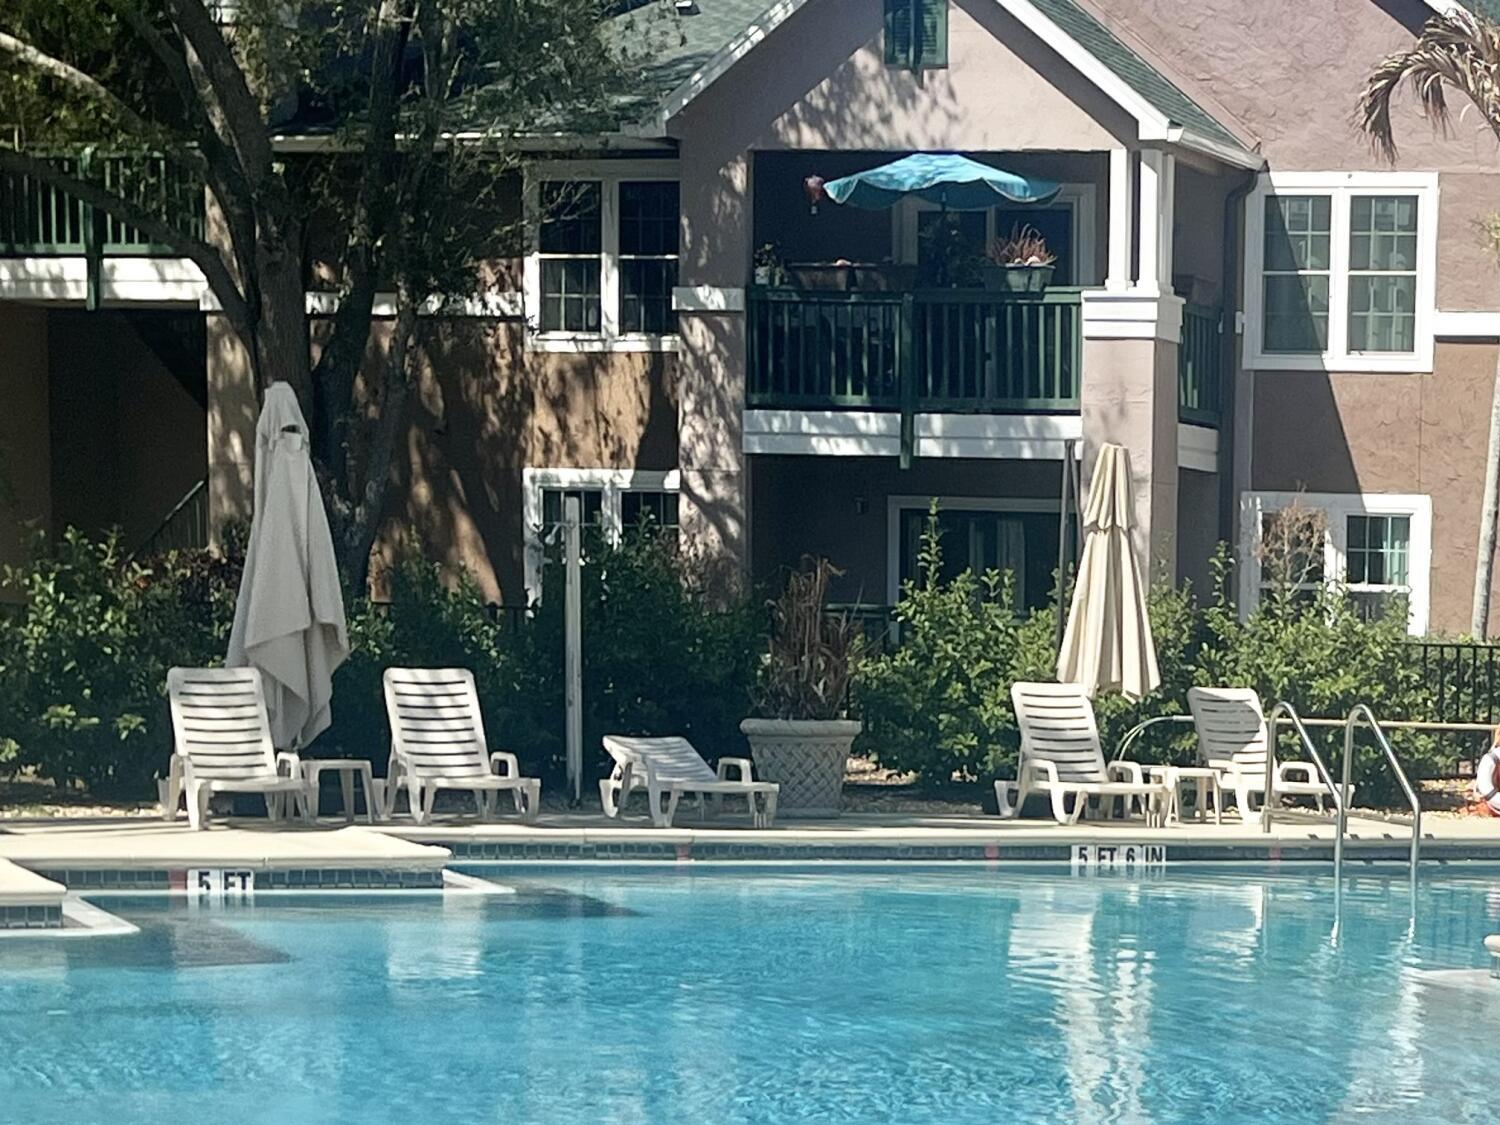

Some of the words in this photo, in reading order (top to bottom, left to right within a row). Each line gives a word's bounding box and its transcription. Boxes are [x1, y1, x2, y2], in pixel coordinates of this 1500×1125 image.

[1078, 846, 1088, 862] 5
[1098, 847, 1117, 862] FT
[1125, 847, 1136, 862] 6
[1145, 846, 1163, 862] IN
[198, 871, 211, 890] 5
[223, 871, 251, 890] FT
